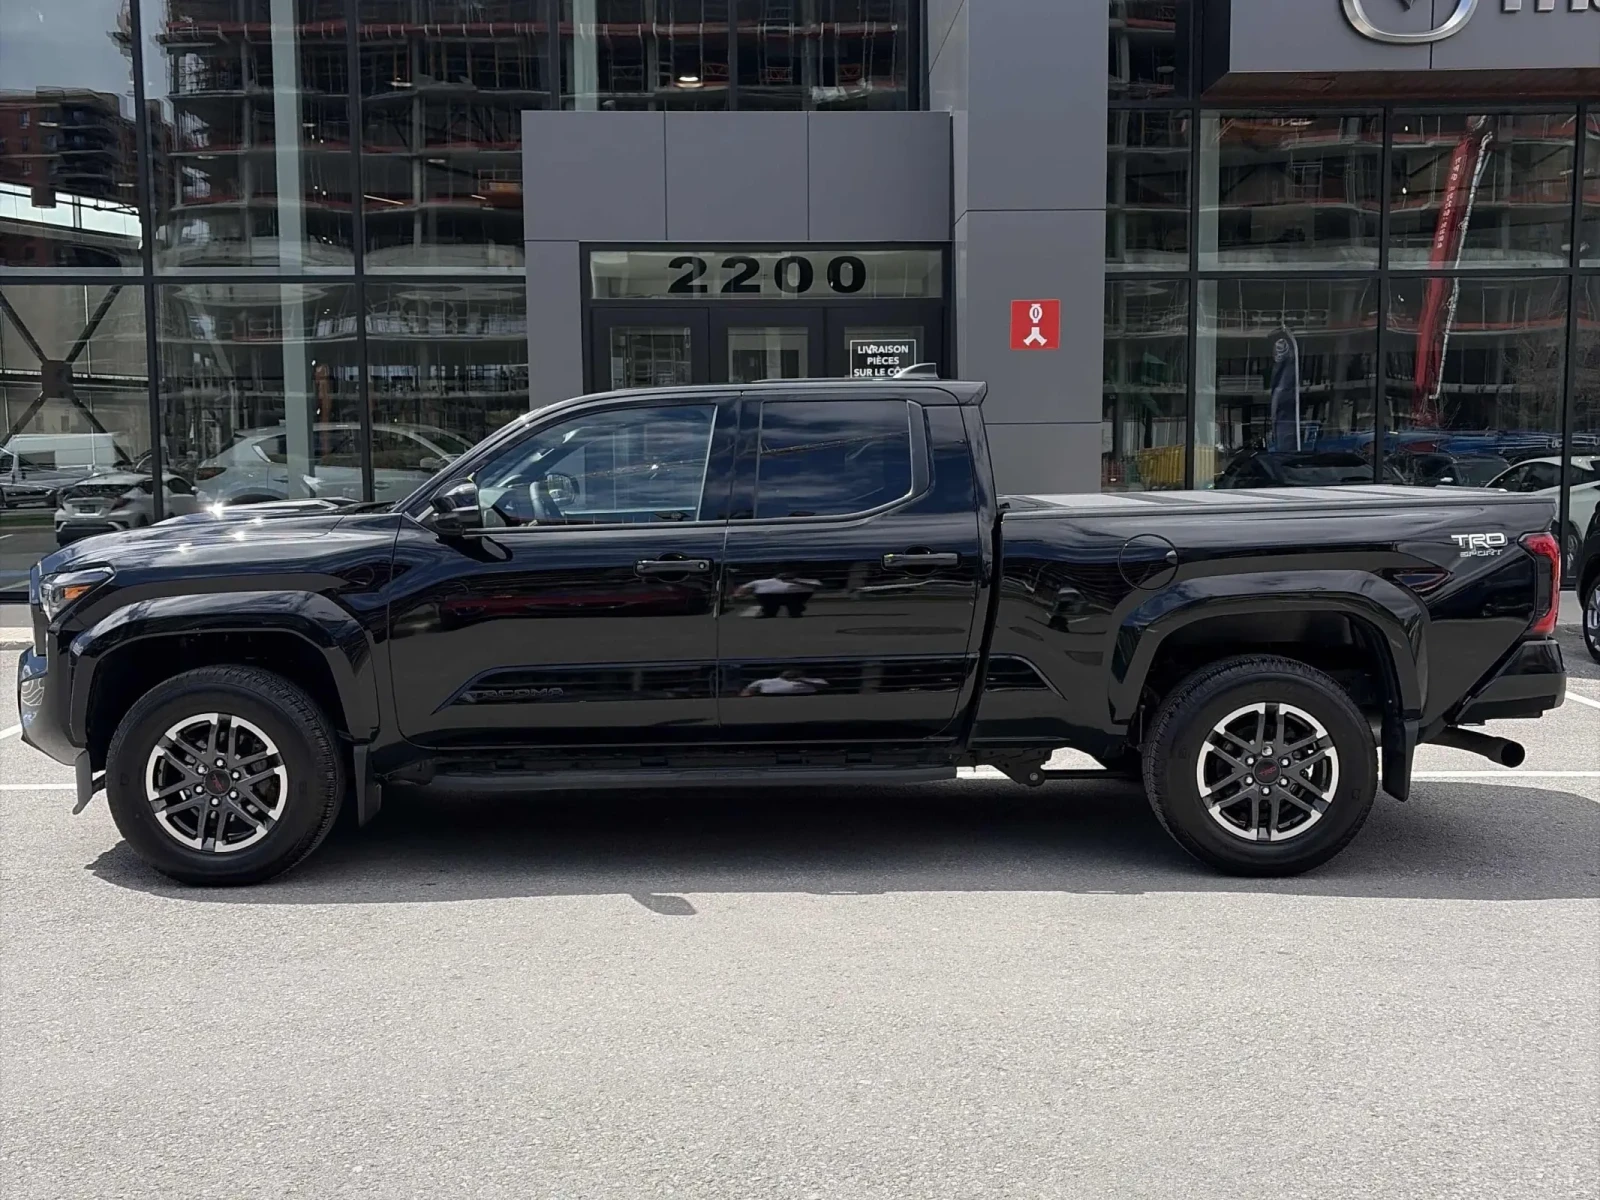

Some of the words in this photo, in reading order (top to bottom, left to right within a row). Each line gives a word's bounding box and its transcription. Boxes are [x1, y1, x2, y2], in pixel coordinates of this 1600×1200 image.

[667, 255, 867, 294] 2200
[857, 345, 909, 354] LIVRAISON
[866, 355, 900, 365] PIÈCES
[853, 368, 873, 377] SUR
[874, 368, 886, 376] LE
[1450, 532, 1506, 549] TRD
[1459, 548, 1503, 558] SPORT
